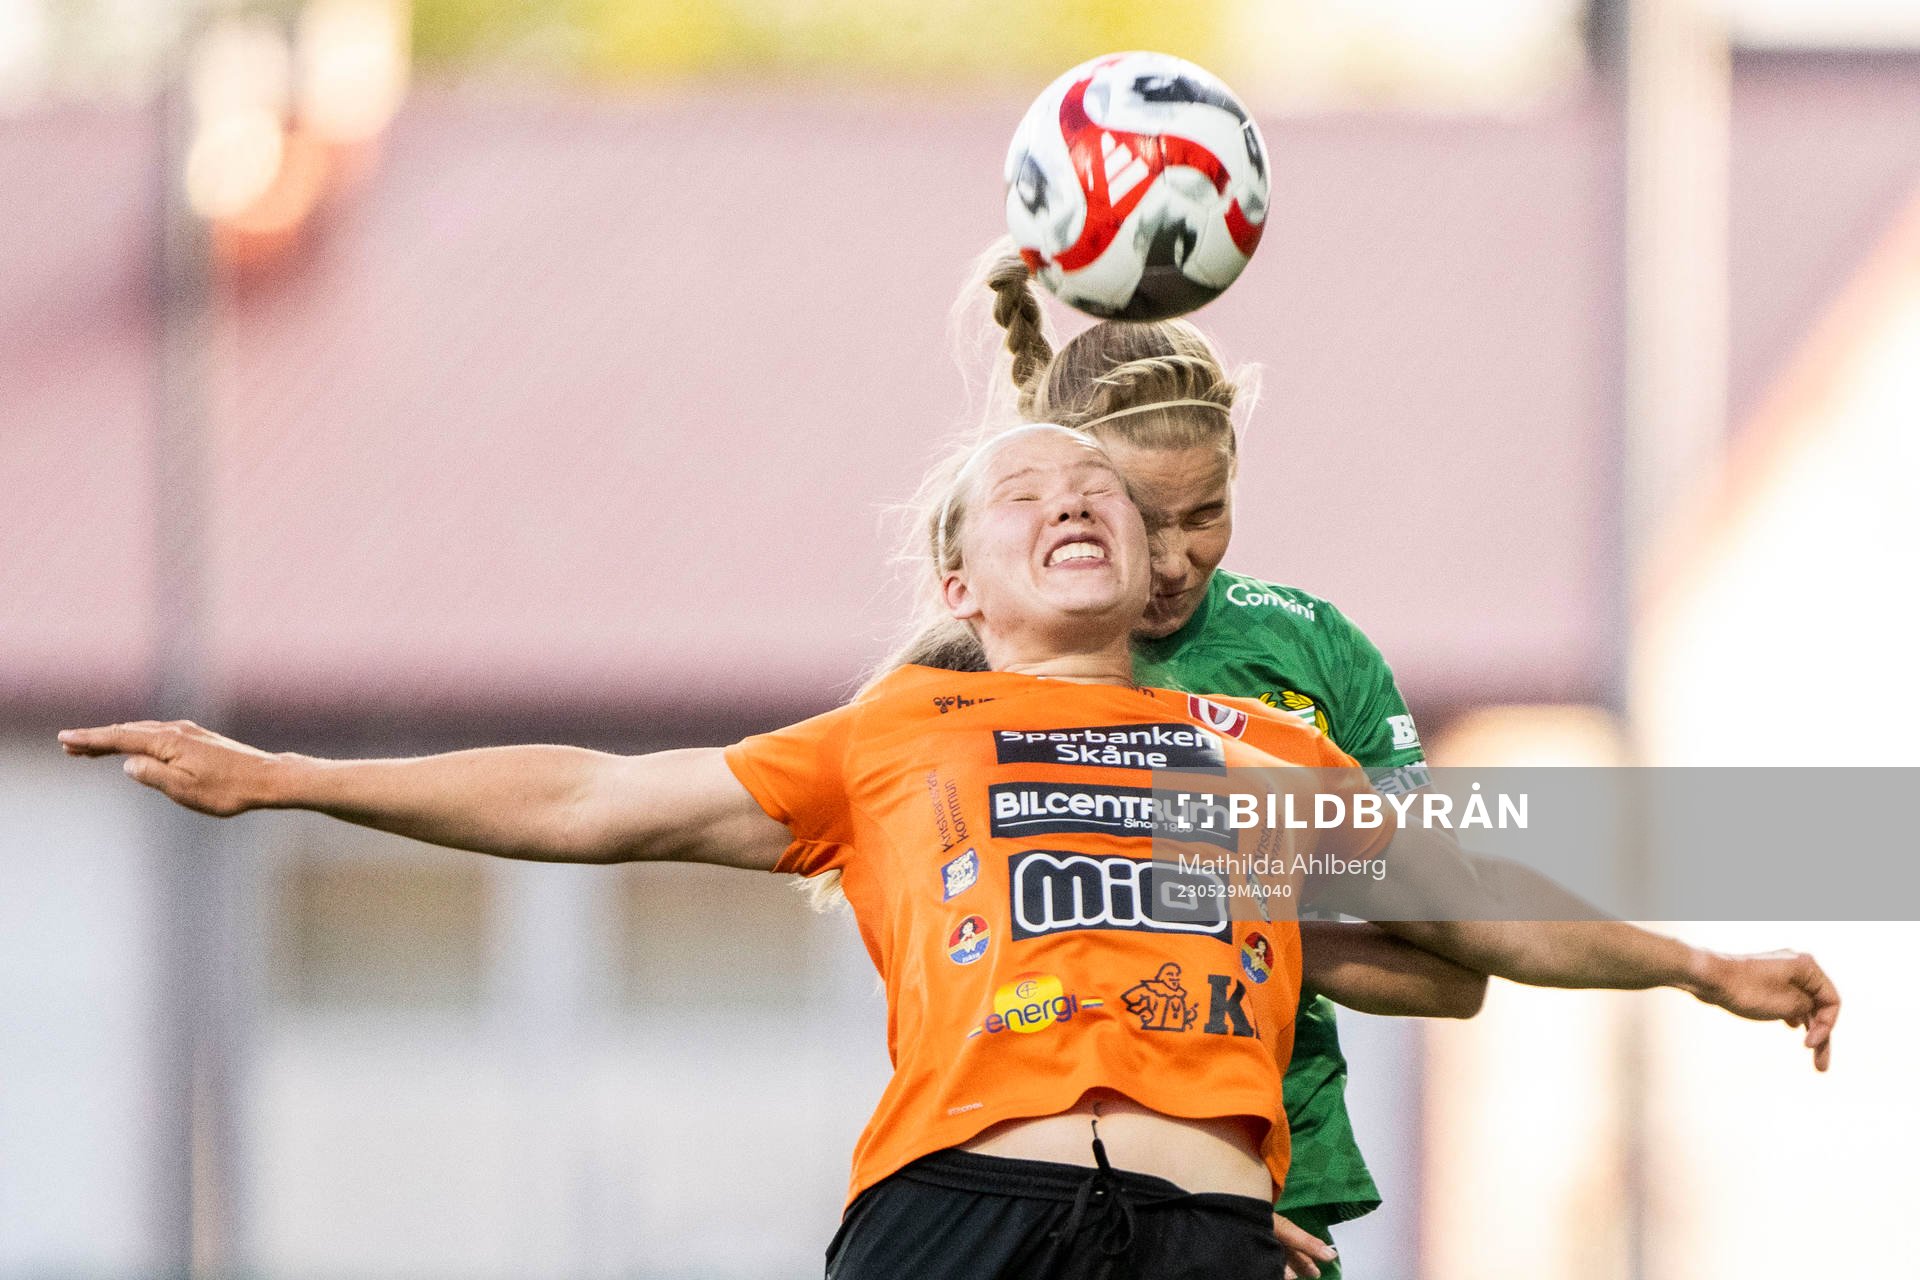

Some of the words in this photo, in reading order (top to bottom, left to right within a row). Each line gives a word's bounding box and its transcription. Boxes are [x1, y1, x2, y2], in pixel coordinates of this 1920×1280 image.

[1001, 726, 1222, 750] Sparbanken
[1057, 744, 1168, 768] Skåne
[1123, 817, 1159, 830] Since
